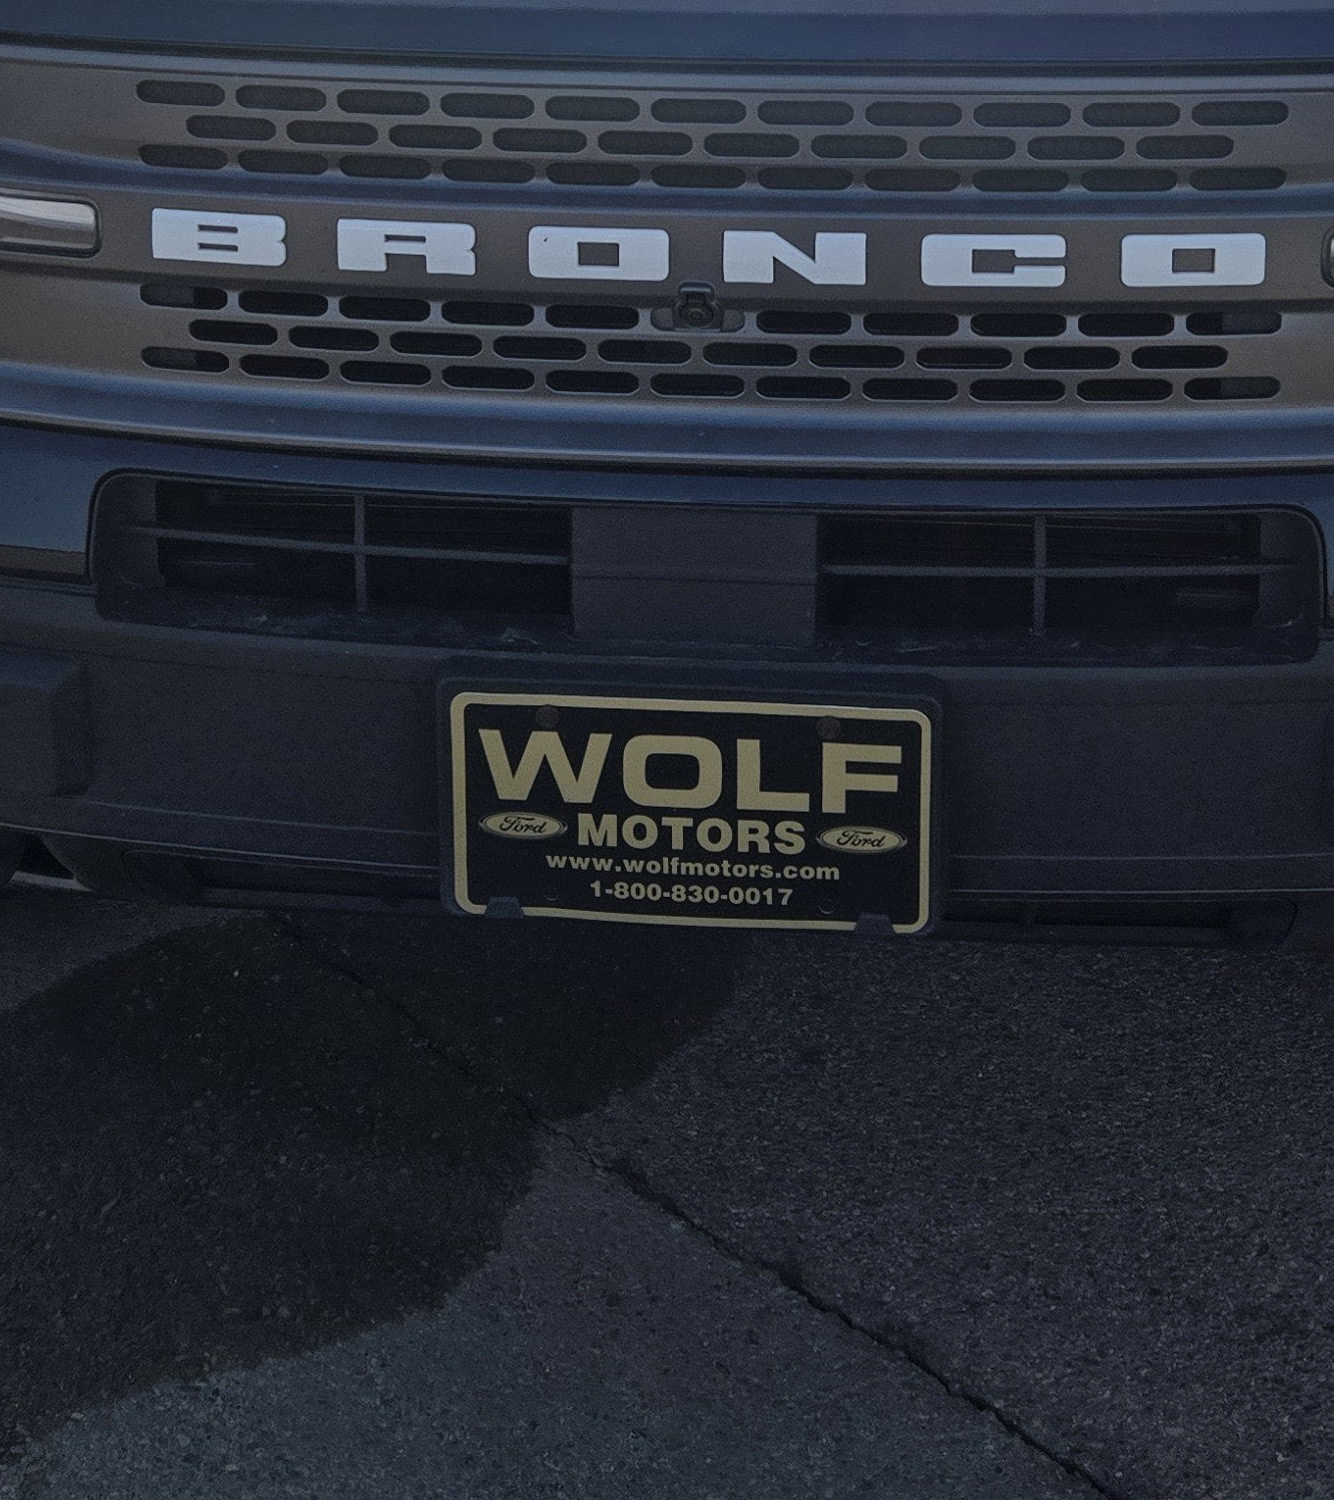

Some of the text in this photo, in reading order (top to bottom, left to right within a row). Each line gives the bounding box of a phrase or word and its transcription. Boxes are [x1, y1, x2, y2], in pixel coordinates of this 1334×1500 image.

[152, 207, 1267, 288] BRONCO
[477, 728, 903, 814] WOLF
[576, 813, 807, 856] MOTORS
[545, 855, 841, 881] www.wolfmotors.com
[589, 880, 794, 906] 1-800-830-0017
